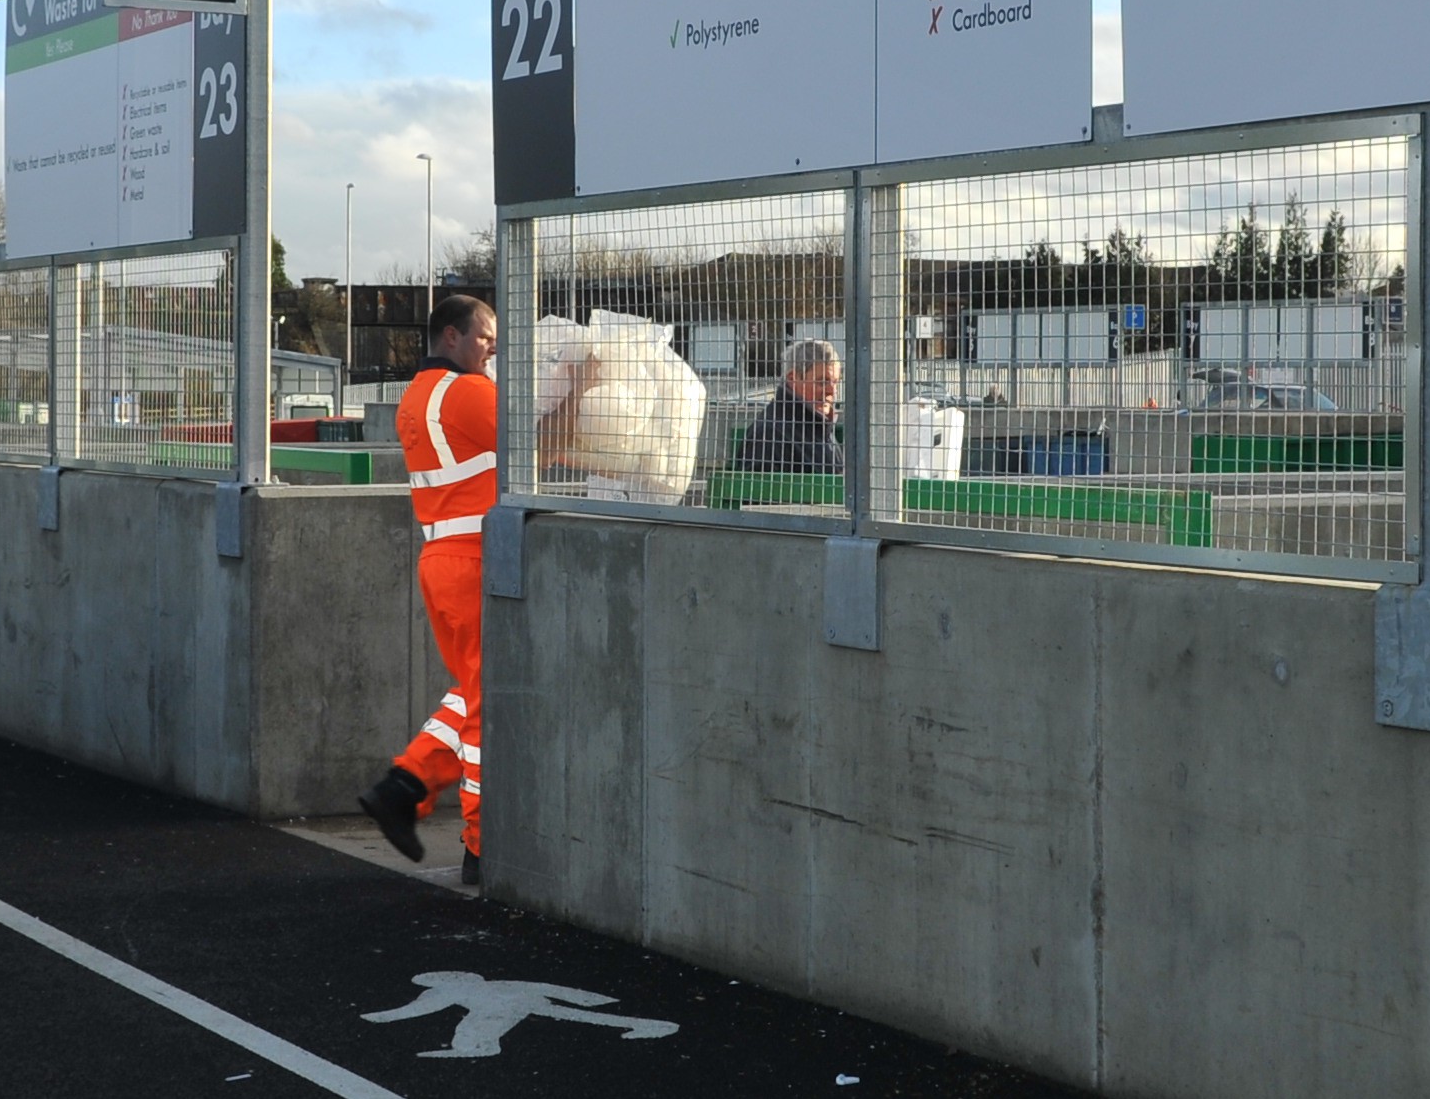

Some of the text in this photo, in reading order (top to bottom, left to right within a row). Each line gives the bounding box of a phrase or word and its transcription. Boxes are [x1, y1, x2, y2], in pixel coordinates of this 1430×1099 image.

[131, 13, 144, 32] No
[144, 9, 166, 27] Thank
[685, 15, 760, 50] Polystyrene
[199, 61, 238, 139] 23
[129, 123, 163, 141] Green waste
[28, 155, 39, 170] that
[57, 149, 65, 164] be
[66, 144, 89, 164] recycled
[90, 147, 97, 159] or
[97, 140, 116, 157] reused
[154, 142, 159, 156] &
[160, 140, 170, 154] soil
[129, 167, 145, 182] Wood
[129, 186, 144, 201] Metal
